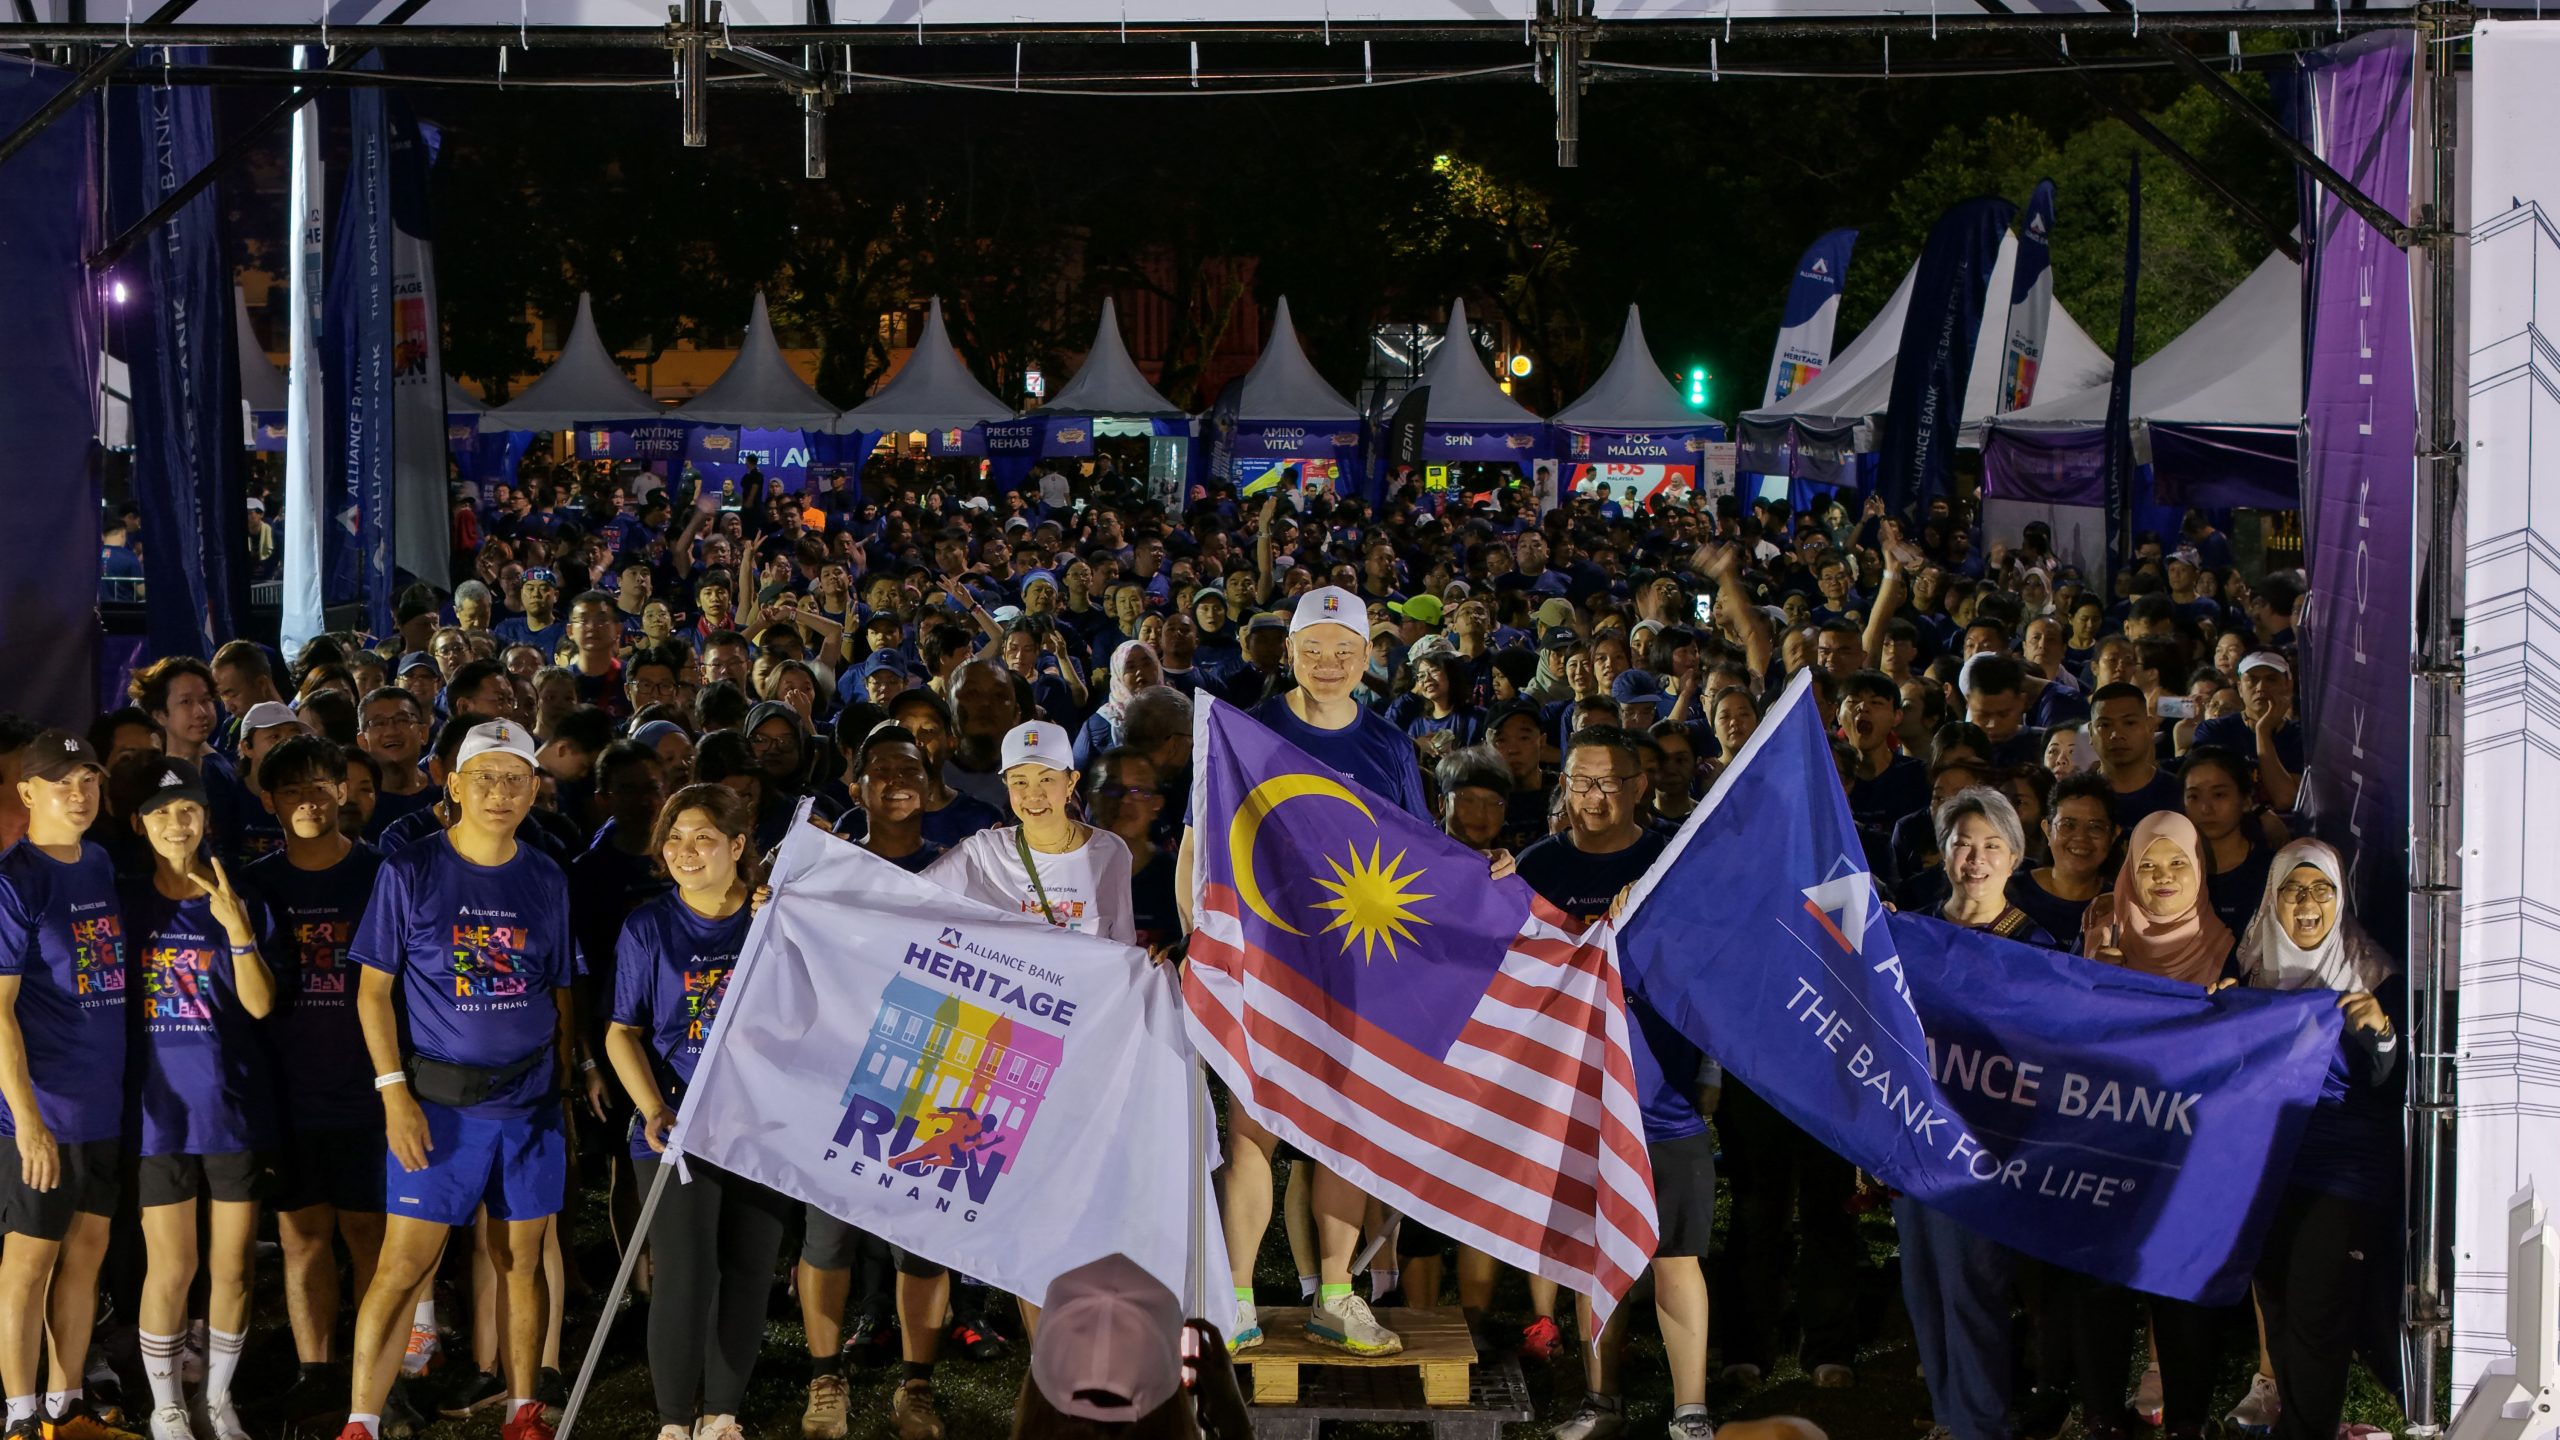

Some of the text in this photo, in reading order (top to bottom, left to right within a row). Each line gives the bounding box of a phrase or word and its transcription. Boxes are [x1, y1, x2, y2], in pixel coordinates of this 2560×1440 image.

[153, 104, 176, 190] BANK
[366, 132, 377, 166] LIFE
[366, 175, 377, 216] FOR
[168, 210, 181, 259] TH
[368, 222, 379, 278] BANK
[370, 279, 379, 320] THE
[1939, 314, 1953, 347] BANK
[1783, 351, 1823, 366] HERITAGE
[1934, 348, 1946, 372] THE
[1922, 384, 1941, 425] BANK
[631, 427, 684, 439] ANYTIME
[635, 440, 680, 451] FITNESS
[986, 426, 1033, 437] PRECISE
[989, 438, 1030, 449] REHAB
[1262, 428, 1306, 438] AMINO
[1445, 435, 1473, 446] SPIN
[1625, 433, 1650, 444] POS
[347, 411, 363, 497] ALLIANCE
[1608, 446, 1668, 457] MALAYSIA
[1911, 427, 1931, 494] ALLIANCE
[2353, 474, 2370, 666] FOR
[1339, 772, 1355, 780] ANK
[2347, 704, 2365, 919] ANK
[471, 909, 500, 917] ALLIANCE
[1579, 897, 1610, 905] ALLIANCE
[160, 932, 206, 942] ALLIANCE BANK
[964, 941, 1066, 988] ALLIANCE BANK
[903, 942, 1078, 1027] HERITAGE
[80, 1001, 100, 1009] 2025
[455, 1000, 528, 1012] 2025 PENANG
[176, 1024, 214, 1033] PENANG
[1784, 976, 1853, 1054] THE
[1845, 1043, 1948, 1147] BANK
[1946, 1131, 2028, 1191] FOR
[2057, 1071, 2203, 1136] BANK
[832, 1092, 1007, 1206] RUN
[823, 1147, 978, 1224] PENANG
